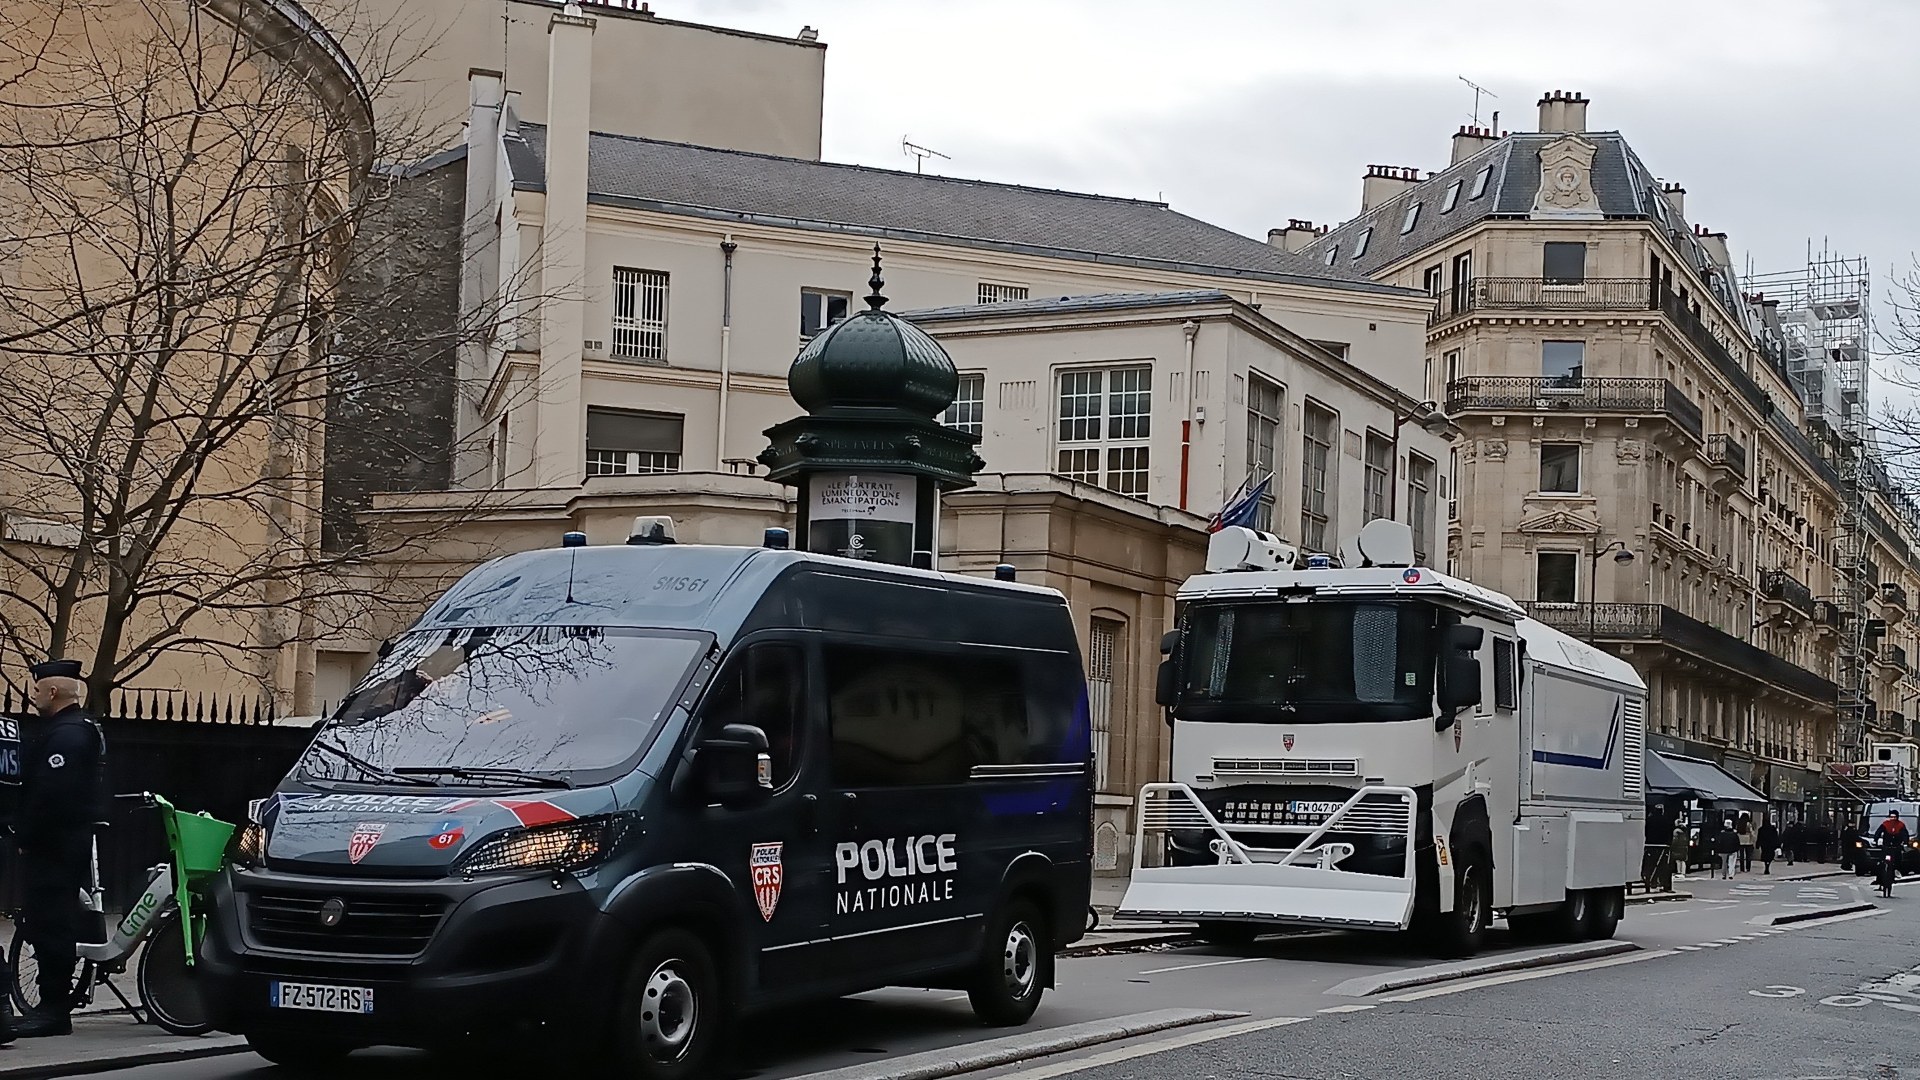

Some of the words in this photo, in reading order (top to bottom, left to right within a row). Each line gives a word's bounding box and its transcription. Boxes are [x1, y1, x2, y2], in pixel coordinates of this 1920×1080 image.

[845, 481, 894, 491] PORTRAIT
[821, 489, 869, 498] LUMINEUX
[872, 490, 900, 500] D'UNE
[652, 576, 690, 591] SMS
[688, 578, 710, 592] 61
[319, 793, 433, 807] POLICE
[308, 803, 425, 814] NATIONALE
[352, 833, 380, 844] CRS
[438, 834, 453, 845] 61
[755, 847, 779, 856] POLICE
[835, 833, 958, 884] POLICE
[754, 866, 780, 887] CRS
[836, 879, 954, 915] NATIONALE
[120, 892, 157, 937] Lime
